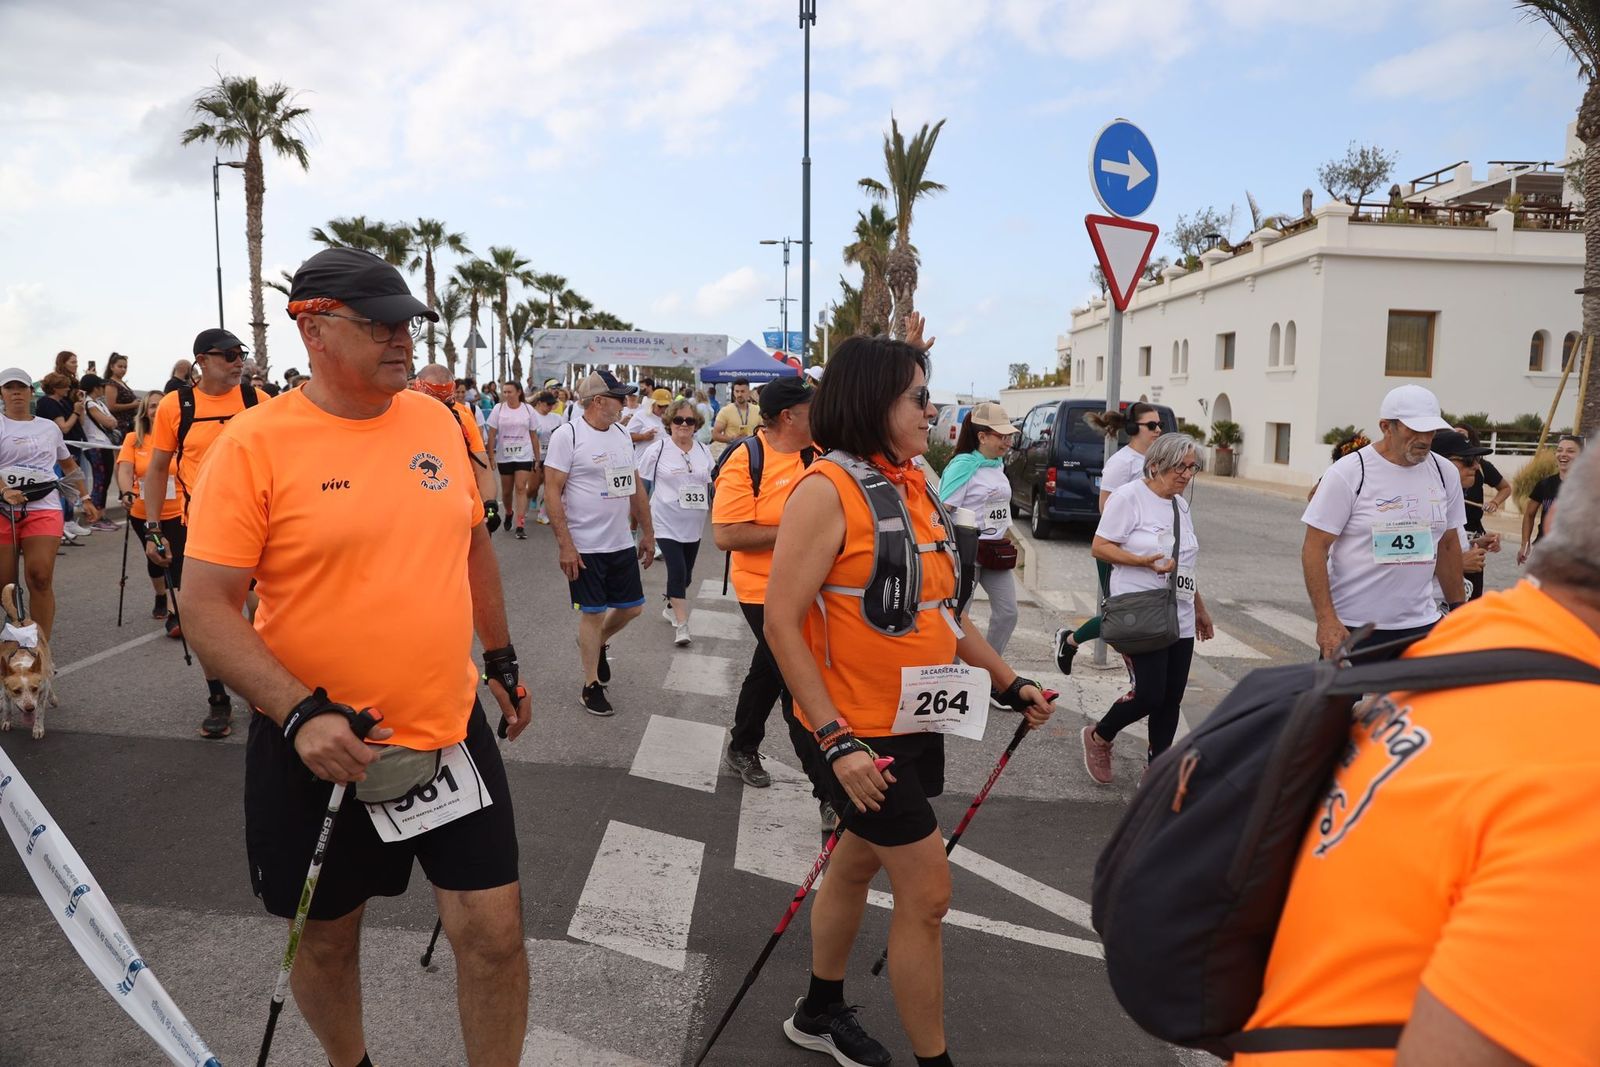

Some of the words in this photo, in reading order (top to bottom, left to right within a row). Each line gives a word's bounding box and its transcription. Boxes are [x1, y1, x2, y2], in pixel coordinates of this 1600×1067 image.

[595, 336, 607, 344] 3A
[609, 336, 651, 344] CARRERA
[322, 478, 350, 491] vive
[613, 474, 632, 488] 870
[686, 492, 705, 502] 333
[990, 508, 1007, 520] 482
[1391, 534, 1415, 550] 43
[1170, 575, 1194, 592] 092
[930, 667, 958, 675] CARRERA
[914, 690, 969, 716] 264
[316, 816, 332, 855] GABEL
[802, 846, 830, 892] FIZAN
